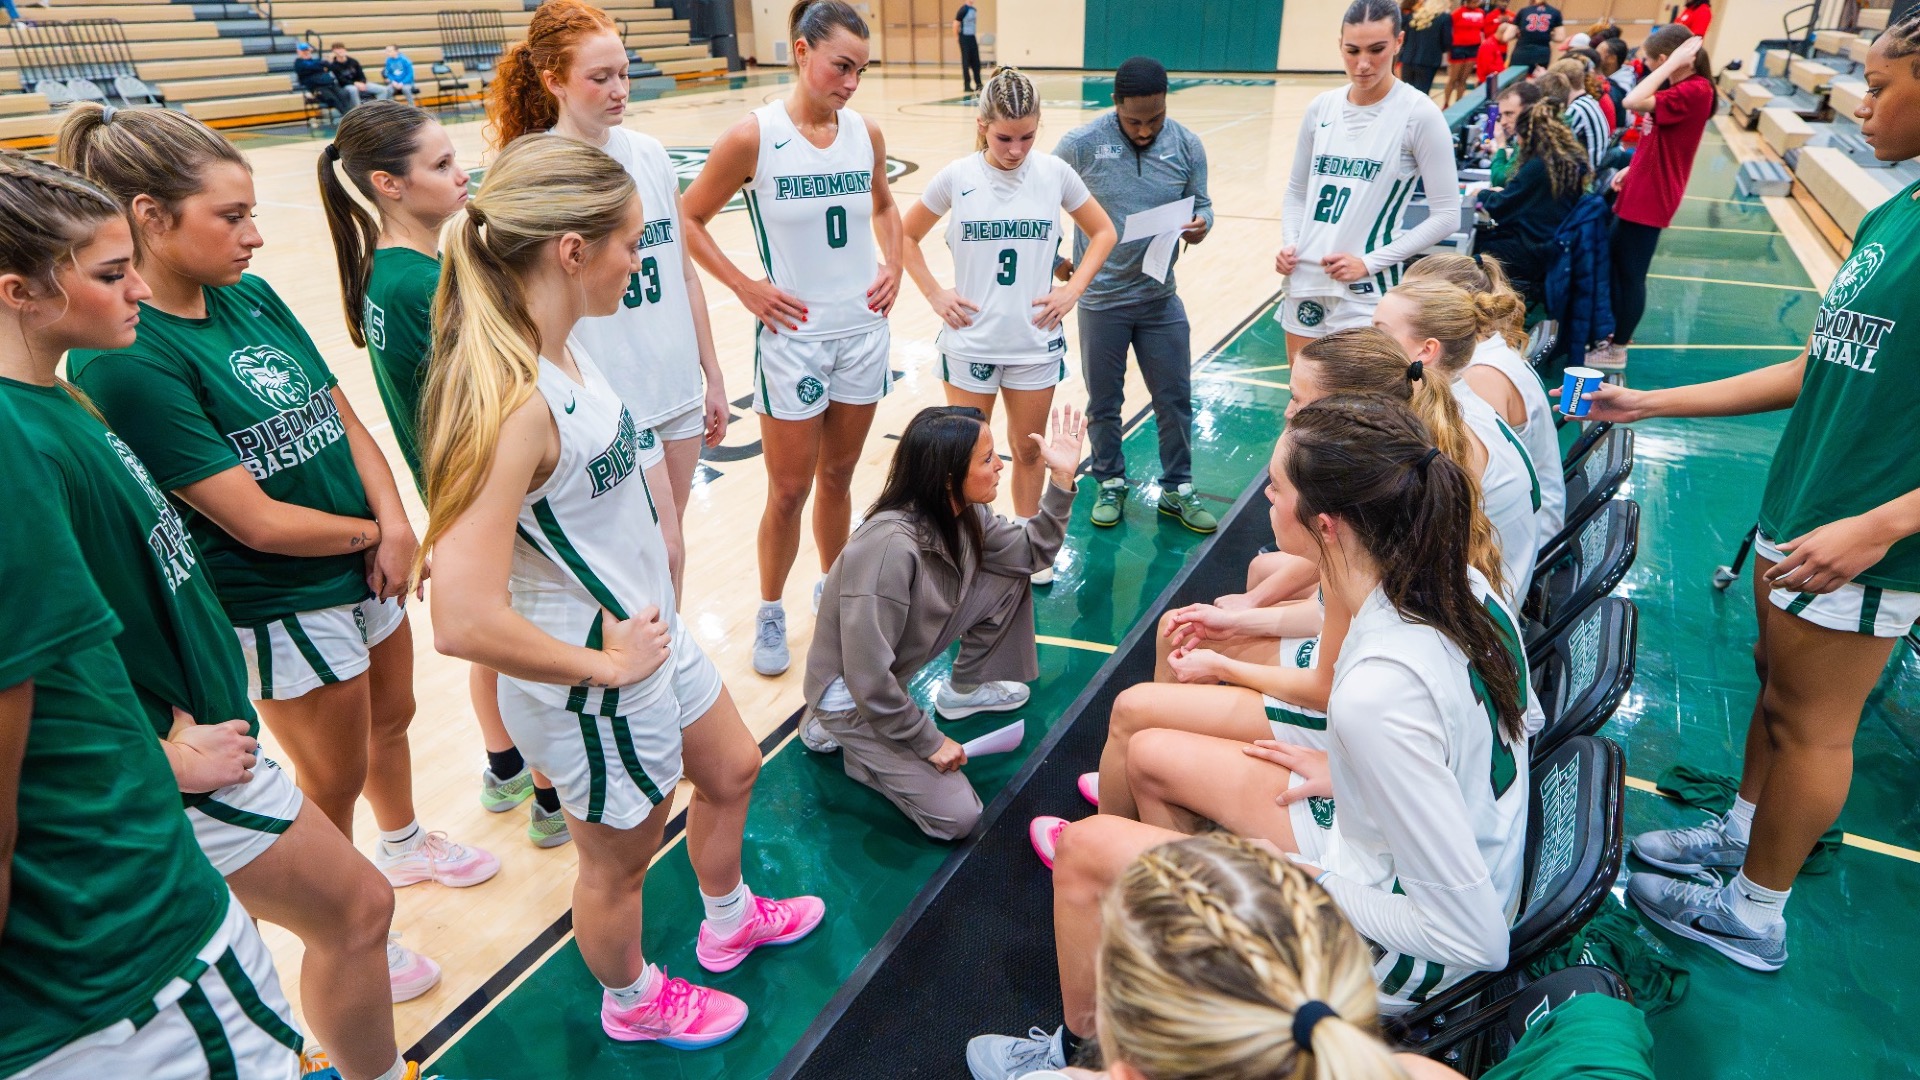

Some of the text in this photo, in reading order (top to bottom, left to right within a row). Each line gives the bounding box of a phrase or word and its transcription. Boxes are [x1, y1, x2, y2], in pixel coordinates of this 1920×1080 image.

[1314, 184, 1351, 224] 20
[825, 205, 847, 249] 0
[961, 218, 1053, 241] PIEDMONT
[623, 256, 662, 309] 33
[996, 248, 1017, 286] 3
[1569, 377, 1585, 413] POWERADE
